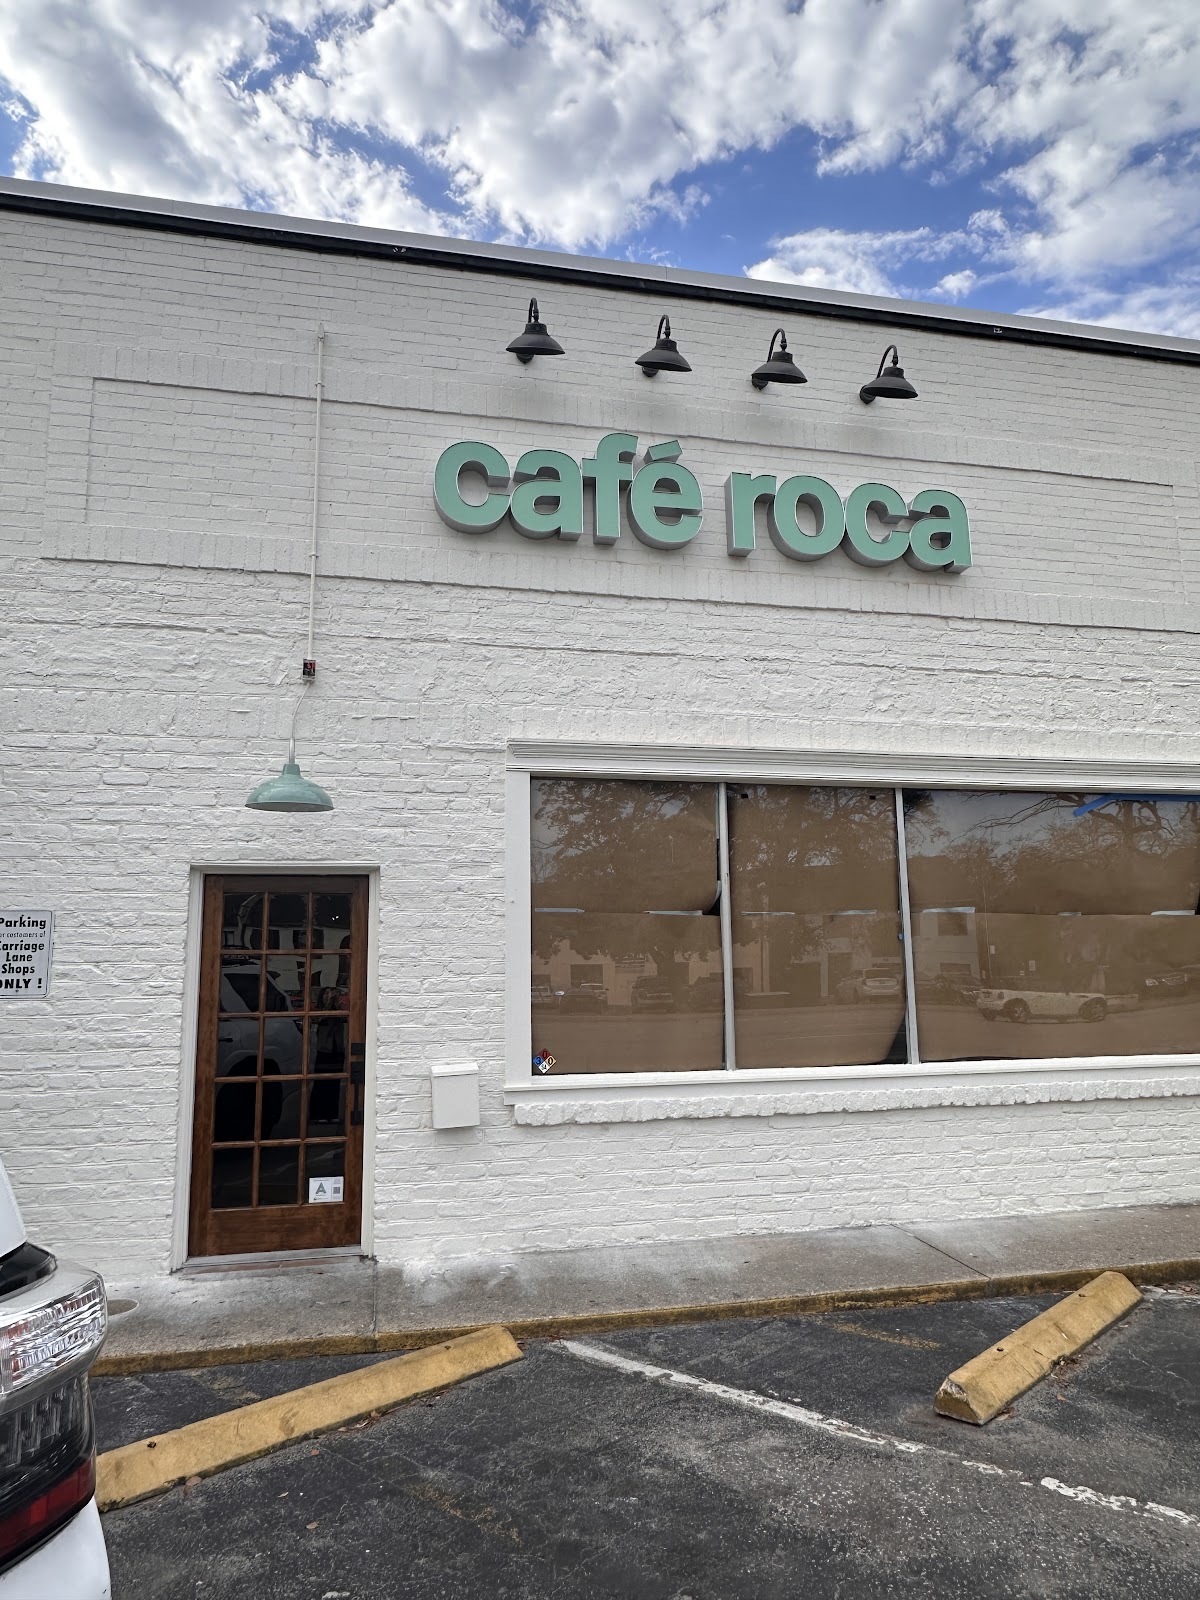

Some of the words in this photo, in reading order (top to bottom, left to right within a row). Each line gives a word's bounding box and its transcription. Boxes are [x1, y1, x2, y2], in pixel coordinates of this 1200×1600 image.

[434, 432, 702, 550] café
[725, 471, 973, 574] roca
[0, 914, 46, 930] Parking
[6, 951, 33, 962] Lane
[1, 963, 35, 975] Shops
[37, 977, 42, 989] !
[315, 1182, 327, 1194] A
